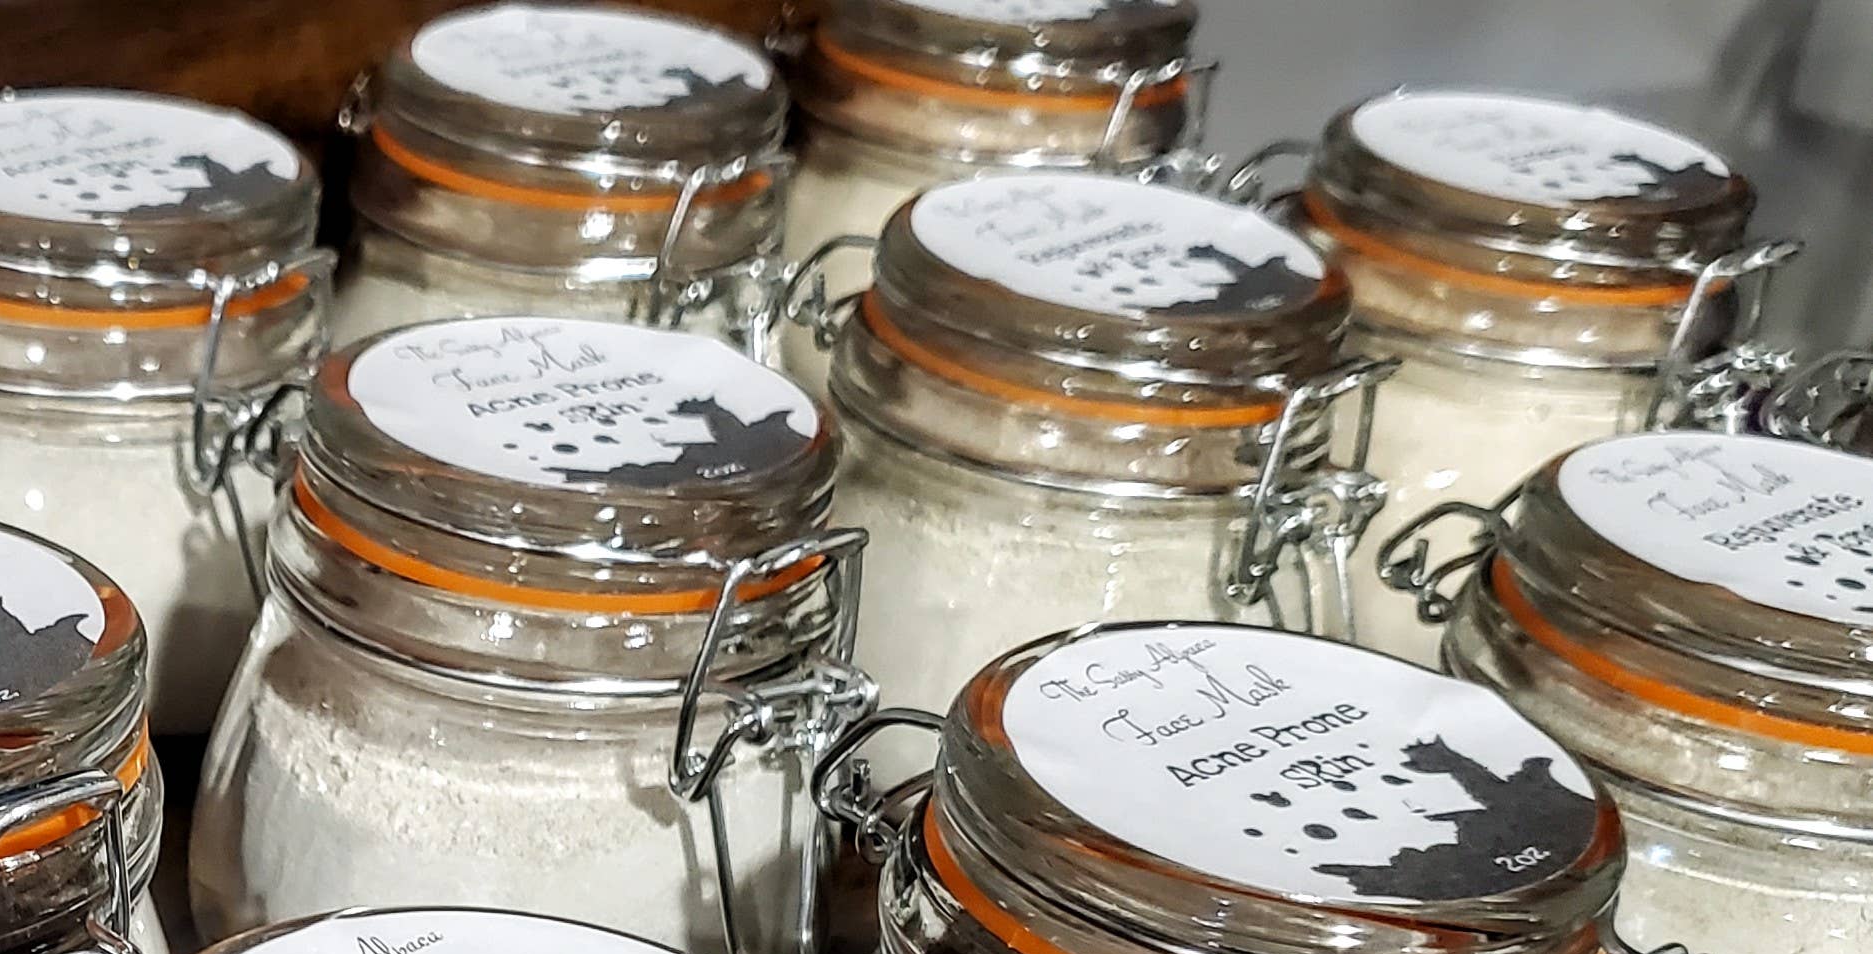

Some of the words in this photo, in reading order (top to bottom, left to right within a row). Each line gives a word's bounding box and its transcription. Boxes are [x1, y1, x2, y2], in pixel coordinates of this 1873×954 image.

[466, 391, 559, 418] Acne
[553, 371, 664, 399] Prone
[1039, 677, 1099, 702] The
[1144, 638, 1217, 673] Alpaca
[1102, 708, 1205, 746] Face
[1195, 663, 1292, 720] Mask
[1165, 741, 1270, 788] Acne
[1249, 702, 1370, 748] Prone
[1492, 845, 1552, 873] 2oz
